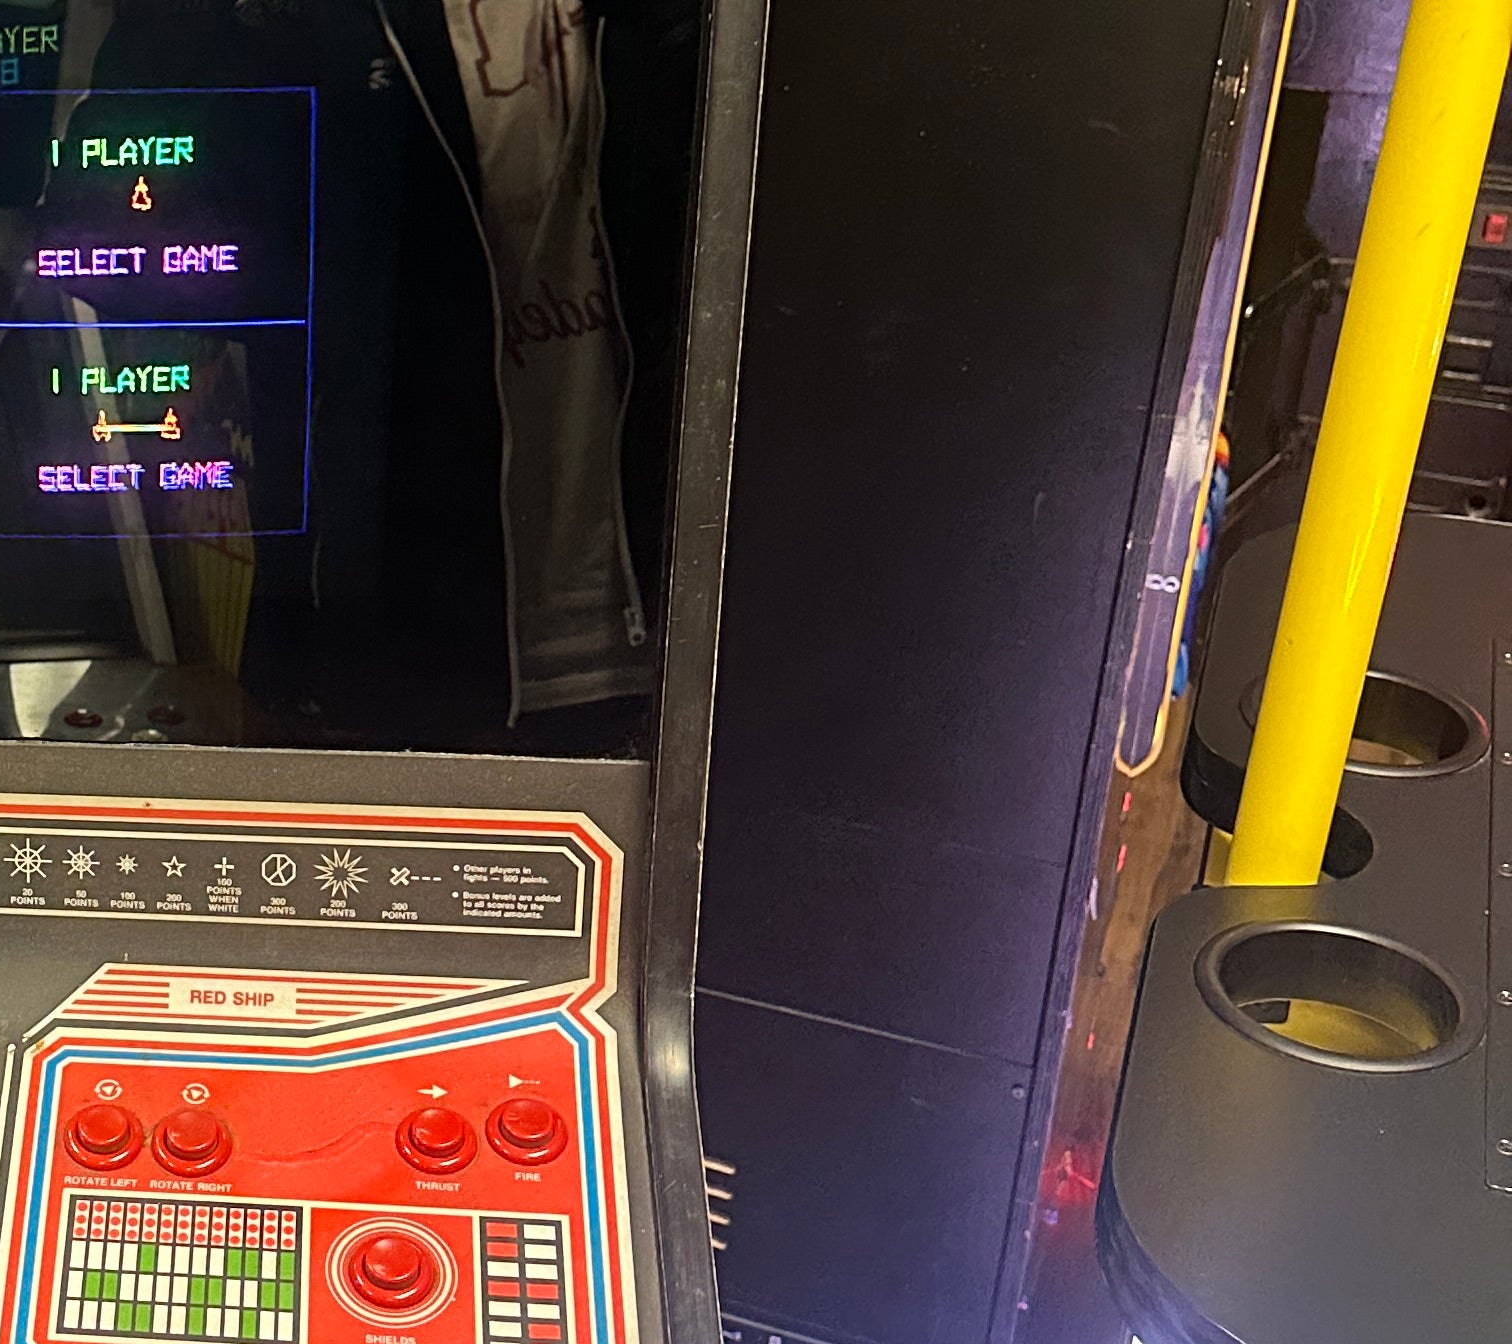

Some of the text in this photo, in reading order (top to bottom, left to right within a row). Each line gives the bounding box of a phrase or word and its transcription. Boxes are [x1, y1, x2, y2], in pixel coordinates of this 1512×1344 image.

[82, 136, 194, 168] PLAYER
[38, 245, 239, 277] SELECT GAME
[81, 365, 190, 395] PLAYER
[38, 461, 233, 492] SELECT GAME
[22, 888, 33, 896] 20
[206, 886, 242, 896] POINTS
[10, 896, 45, 905] POINTS
[64, 898, 99, 908] POINTS
[209, 895, 238, 904] WHEN
[110, 900, 145, 910] POINTS
[157, 902, 191, 911] POINTS
[208, 903, 239, 913] WHITE
[260, 905, 296, 915] POINTS
[320, 908, 356, 918] POINTS
[381, 911, 418, 920] POINTS
[189, 988, 275, 1008] RED SHIP
[64, 1175, 138, 1188] ROTATE LEFT
[514, 1172, 541, 1182] FIRE
[149, 1179, 232, 1193] ROTATE RIGHT
[415, 1180, 460, 1192] THRUST
